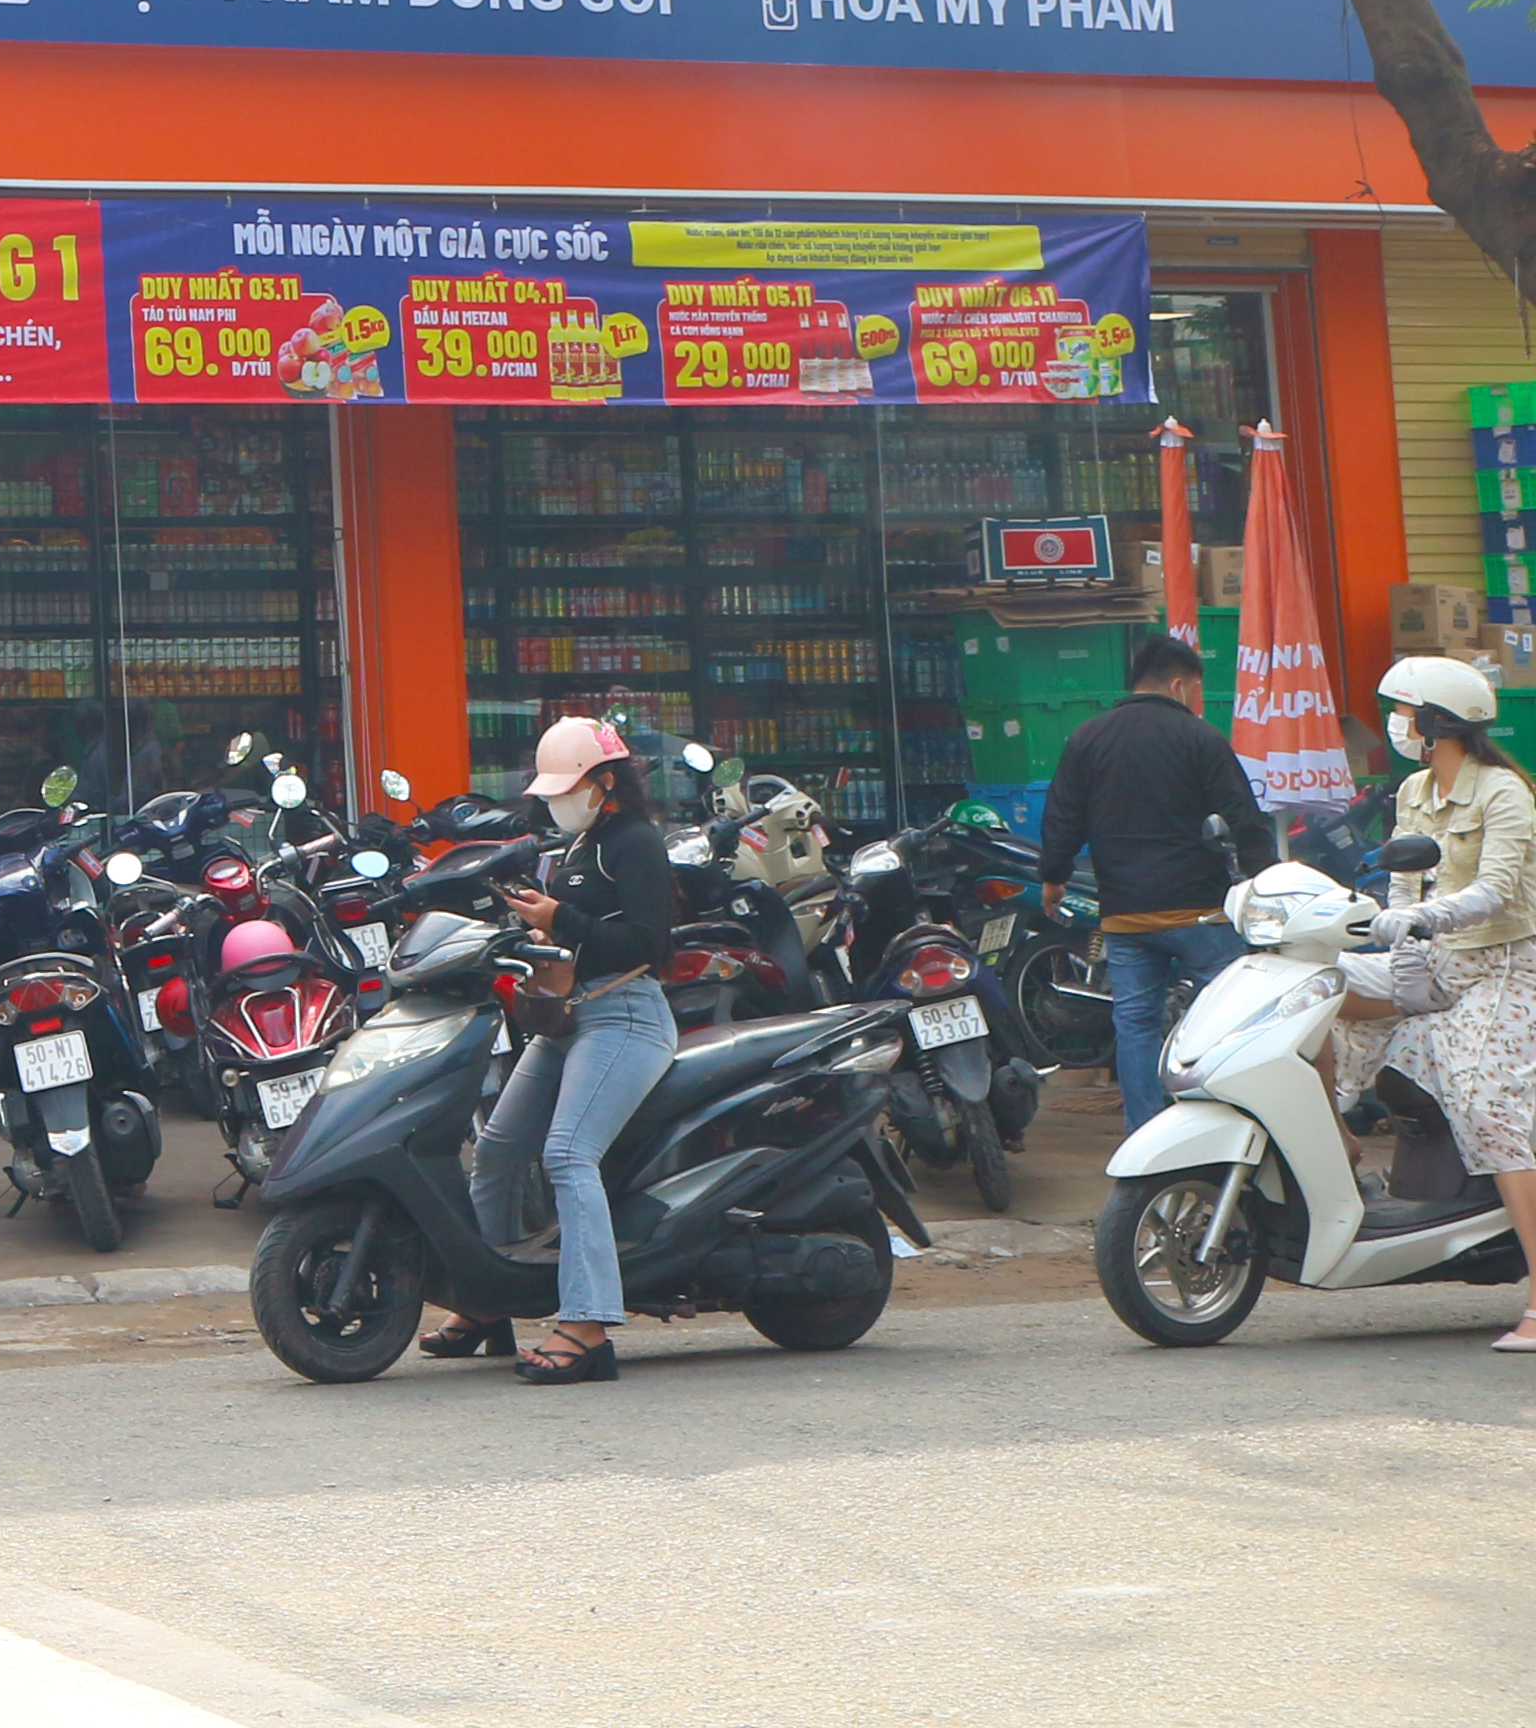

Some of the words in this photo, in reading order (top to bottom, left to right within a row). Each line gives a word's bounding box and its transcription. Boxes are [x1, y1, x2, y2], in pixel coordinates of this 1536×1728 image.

[234, 209, 284, 255] MỖI
[292, 216, 365, 257] NGÀY
[373, 218, 431, 262] MỘT
[439, 220, 486, 259] GIÁ
[494, 227, 549, 264] CỰC
[556, 220, 609, 261] SỐC
[58, 234, 80, 302] 1
[142, 277, 183, 300] DUY
[189, 271, 244, 301] NHẤT
[249, 277, 299, 301] 03.11
[411, 278, 452, 303] DUY
[456, 273, 508, 303] NHẤT
[513, 279, 564, 304] 04.11
[666, 284, 705, 306] DUY
[709, 278, 761, 306] NHẤT
[766, 285, 813, 307] 05.11
[916, 286, 954, 308] DUY
[958, 279, 1007, 308] NHẤT
[1009, 285, 1056, 307] 06.11
[142, 306, 164, 322] TÁO
[167, 306, 187, 322] TÚI
[190, 308, 216, 322] NAM
[218, 308, 237, 322] PHI
[413, 306, 441, 325] DẦU
[443, 306, 461, 325] ĂN
[463, 311, 508, 326] MEIZAN
[990, 312, 1037, 324] SUNLIGHT
[343, 318, 385, 343] 1.5KG
[920, 1001, 972, 1025] 60-C2
[919, 1017, 980, 1048] 233.07
[26, 1040, 75, 1064] 50-N1
[24, 1056, 87, 1091] 414.26
